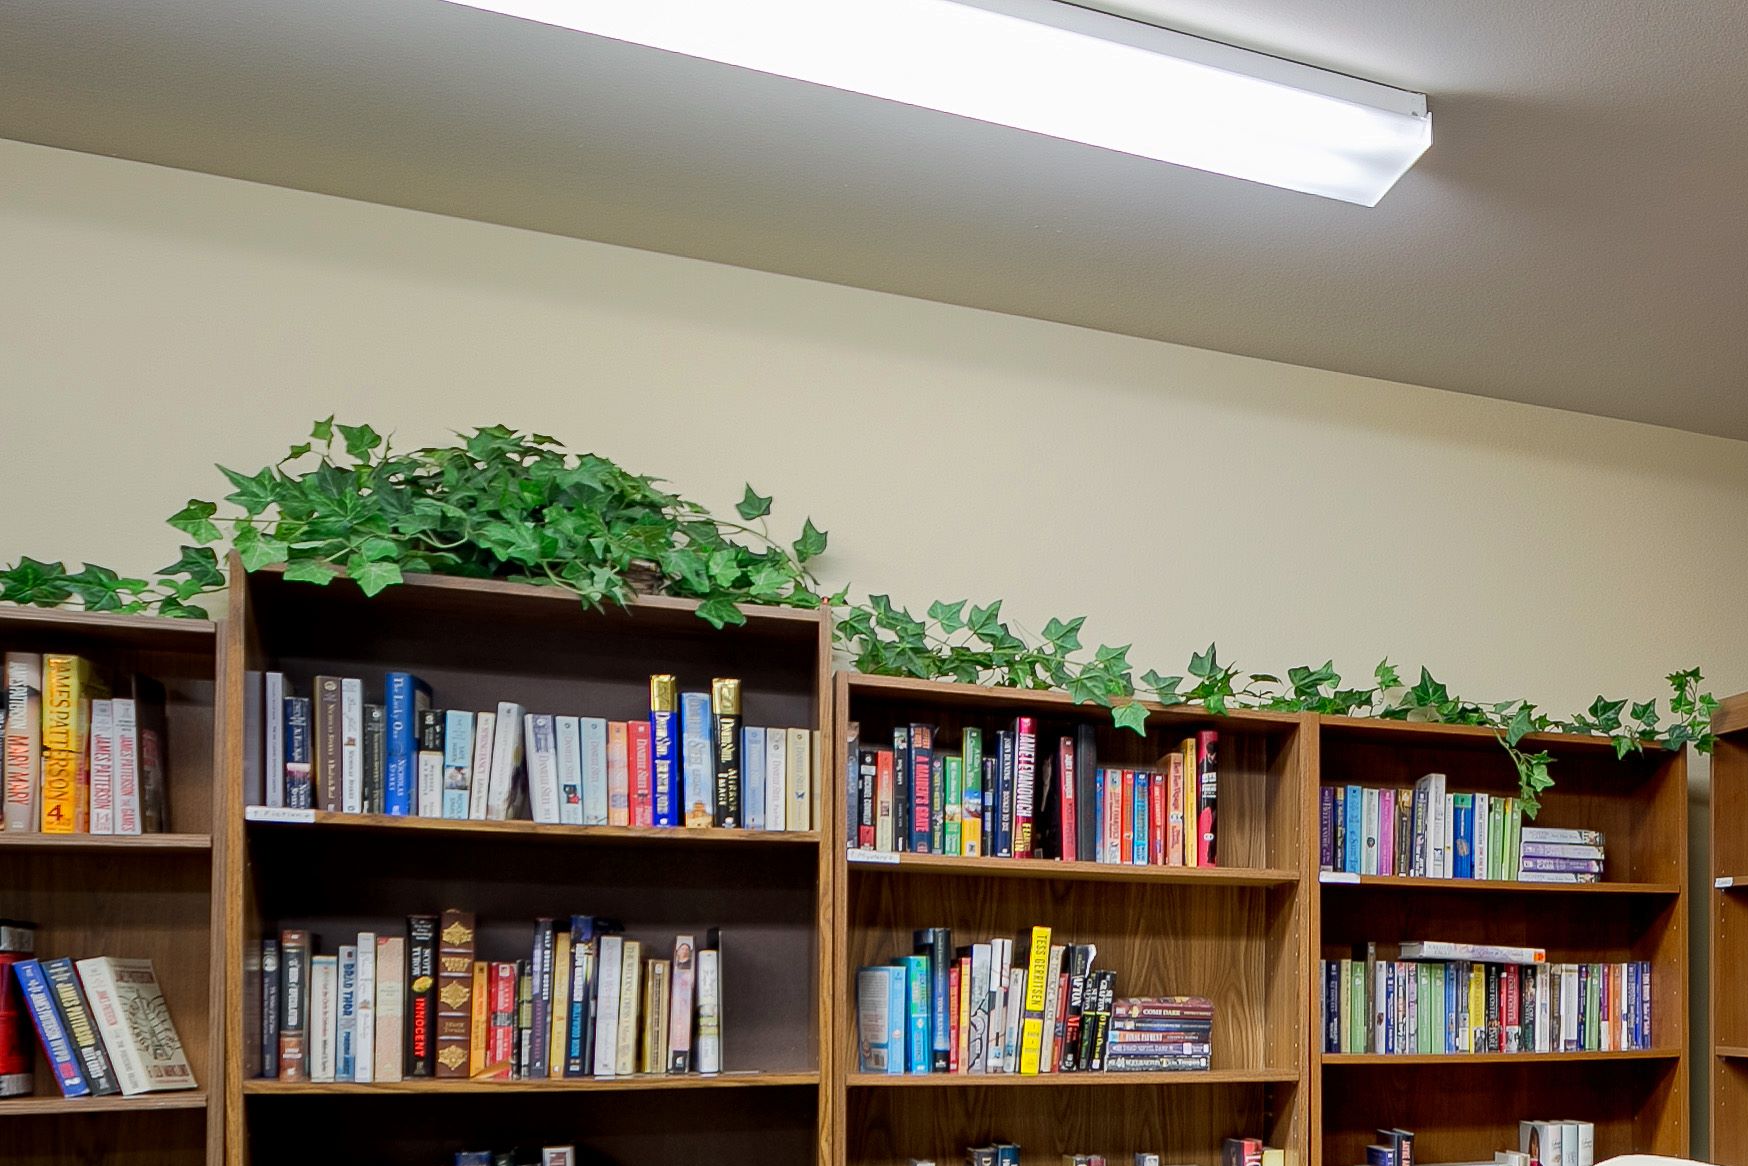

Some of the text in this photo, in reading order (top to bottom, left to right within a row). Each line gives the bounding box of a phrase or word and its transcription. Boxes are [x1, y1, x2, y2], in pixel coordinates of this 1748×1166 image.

[46, 658, 73, 801] JAMES PATTERSON
[7, 735, 29, 806] MARY MARY
[92, 733, 114, 810] JAMES PATTERSON
[118, 733, 136, 832] JAMES PATTERSON GAMES
[914, 764, 929, 832] MAIDEN'S GRAVE
[1016, 732, 1036, 817] JANET EVANOVICH
[340, 963, 354, 1016] BRAD THOR
[421, 948, 431, 975] SCOTT
[1029, 935, 1049, 1006] TESS GERRITSEN
[413, 997, 426, 1057] INNOCENT
